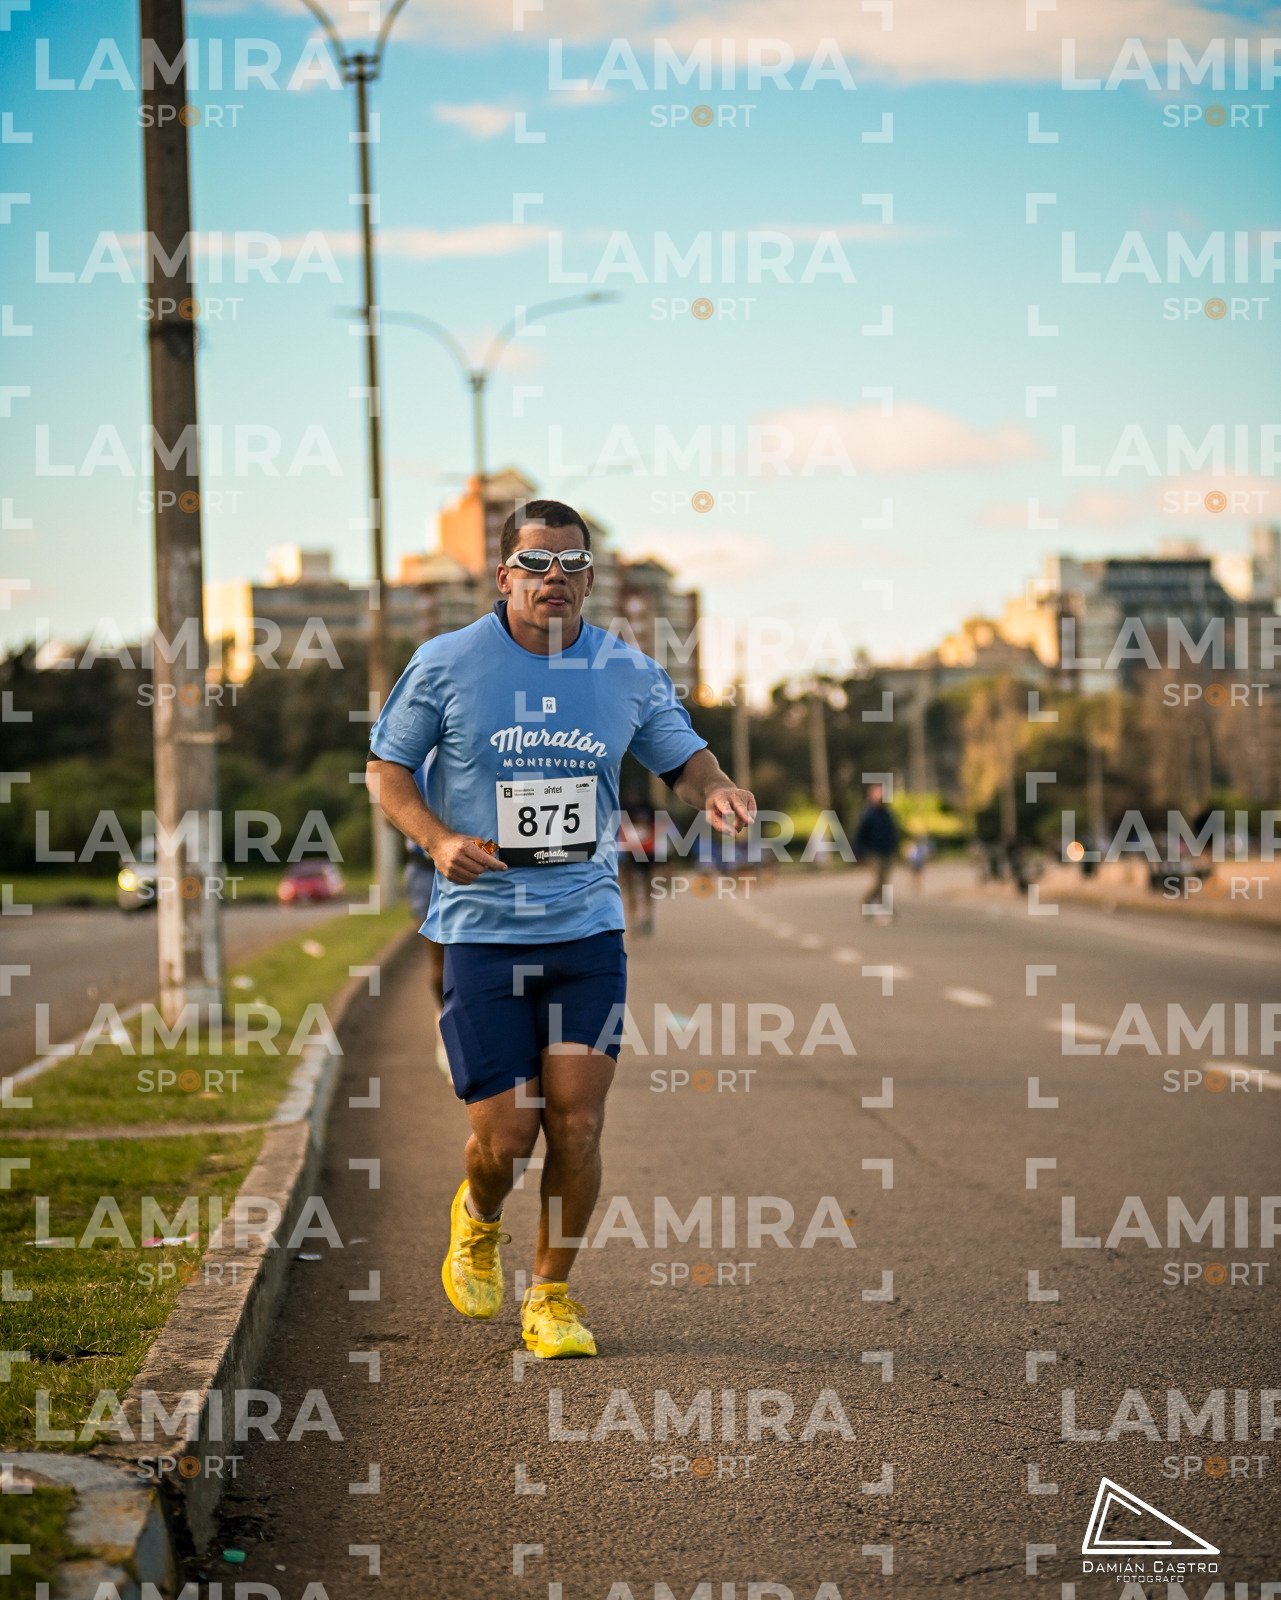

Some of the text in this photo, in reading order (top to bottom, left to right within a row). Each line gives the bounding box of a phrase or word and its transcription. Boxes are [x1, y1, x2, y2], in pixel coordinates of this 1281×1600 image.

[490, 725, 607, 757] Maratón
[503, 758, 596, 769] MONTEVIDEO
[518, 803, 580, 837] 875
